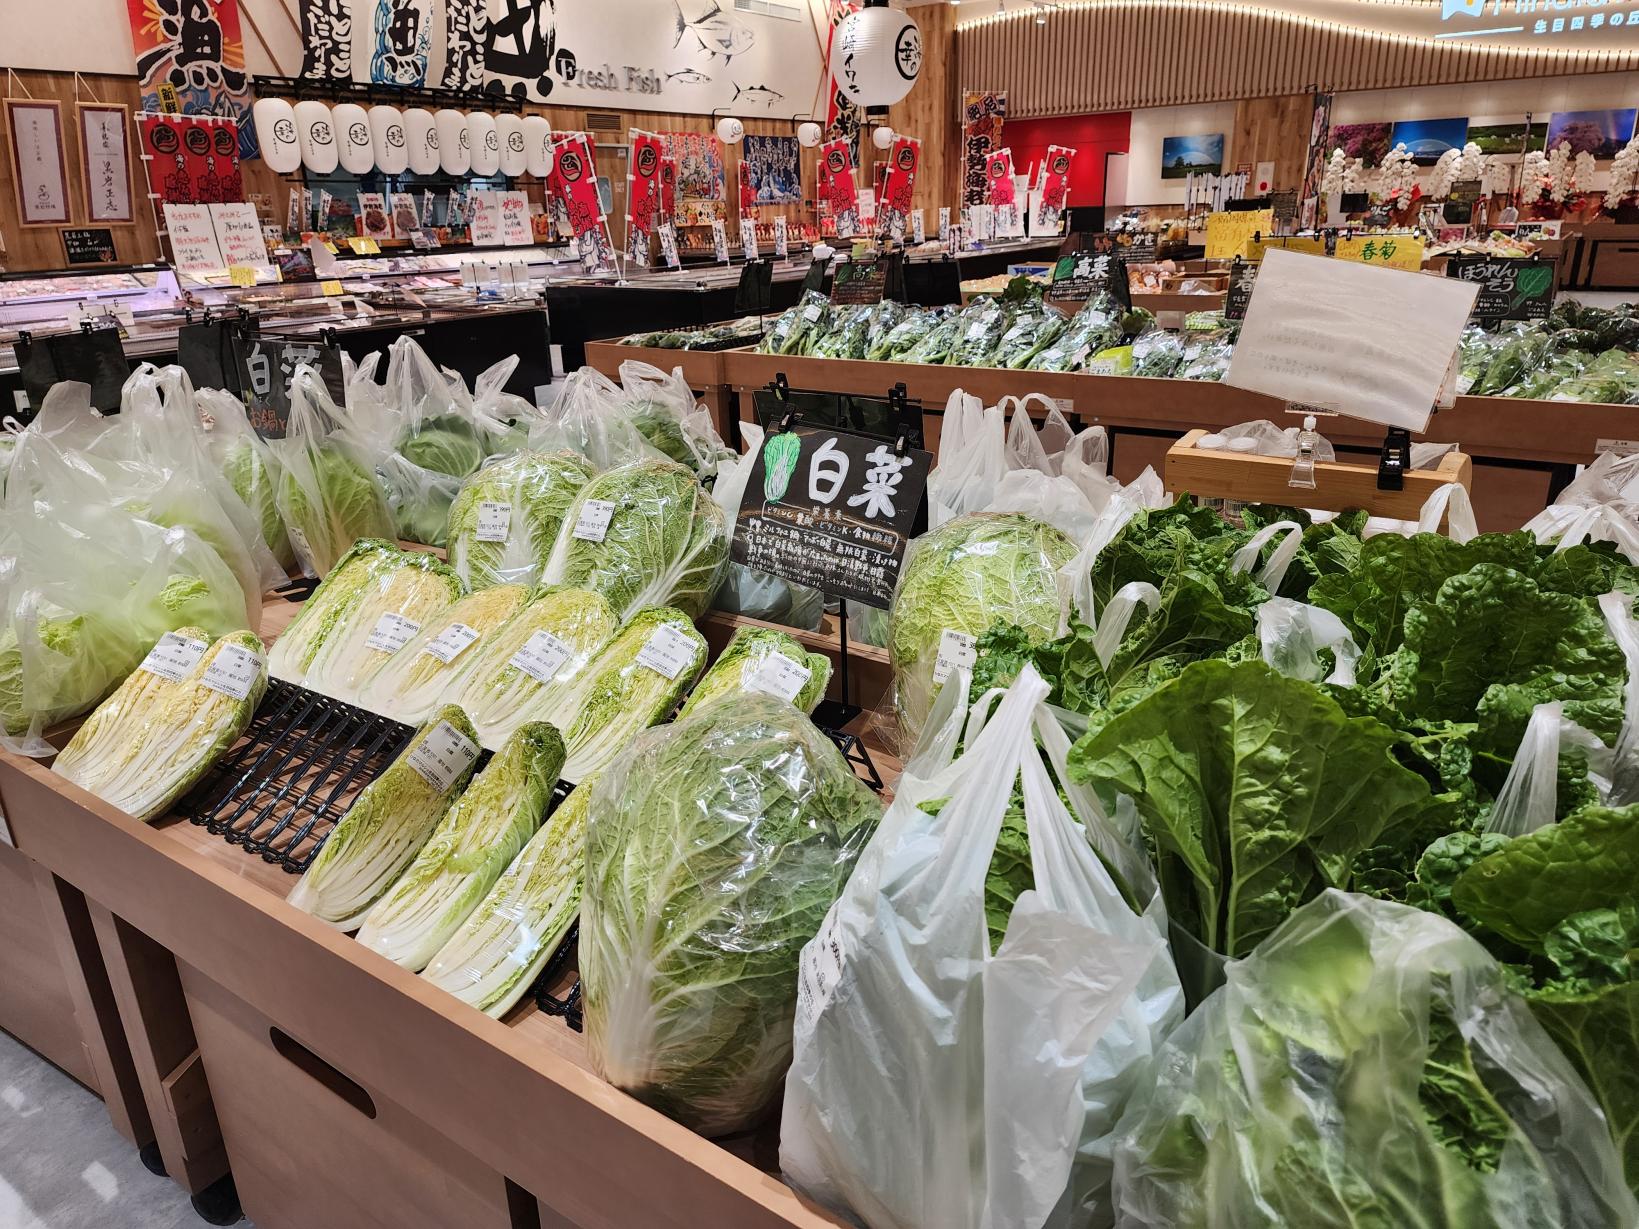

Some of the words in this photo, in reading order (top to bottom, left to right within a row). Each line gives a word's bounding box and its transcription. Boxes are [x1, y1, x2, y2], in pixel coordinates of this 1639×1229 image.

[558, 57, 619, 91] Fresh
[623, 66, 661, 95] Fish
[1360, 240, 1397, 260] 春菊
[1073, 255, 1112, 279] 高菜
[1458, 261, 1519, 280] ほうれん
[1486, 278, 1514, 292] そう
[808, 437, 913, 519] 白菜
[188, 643, 205, 654] 110円
[460, 745, 476, 761] 110円
